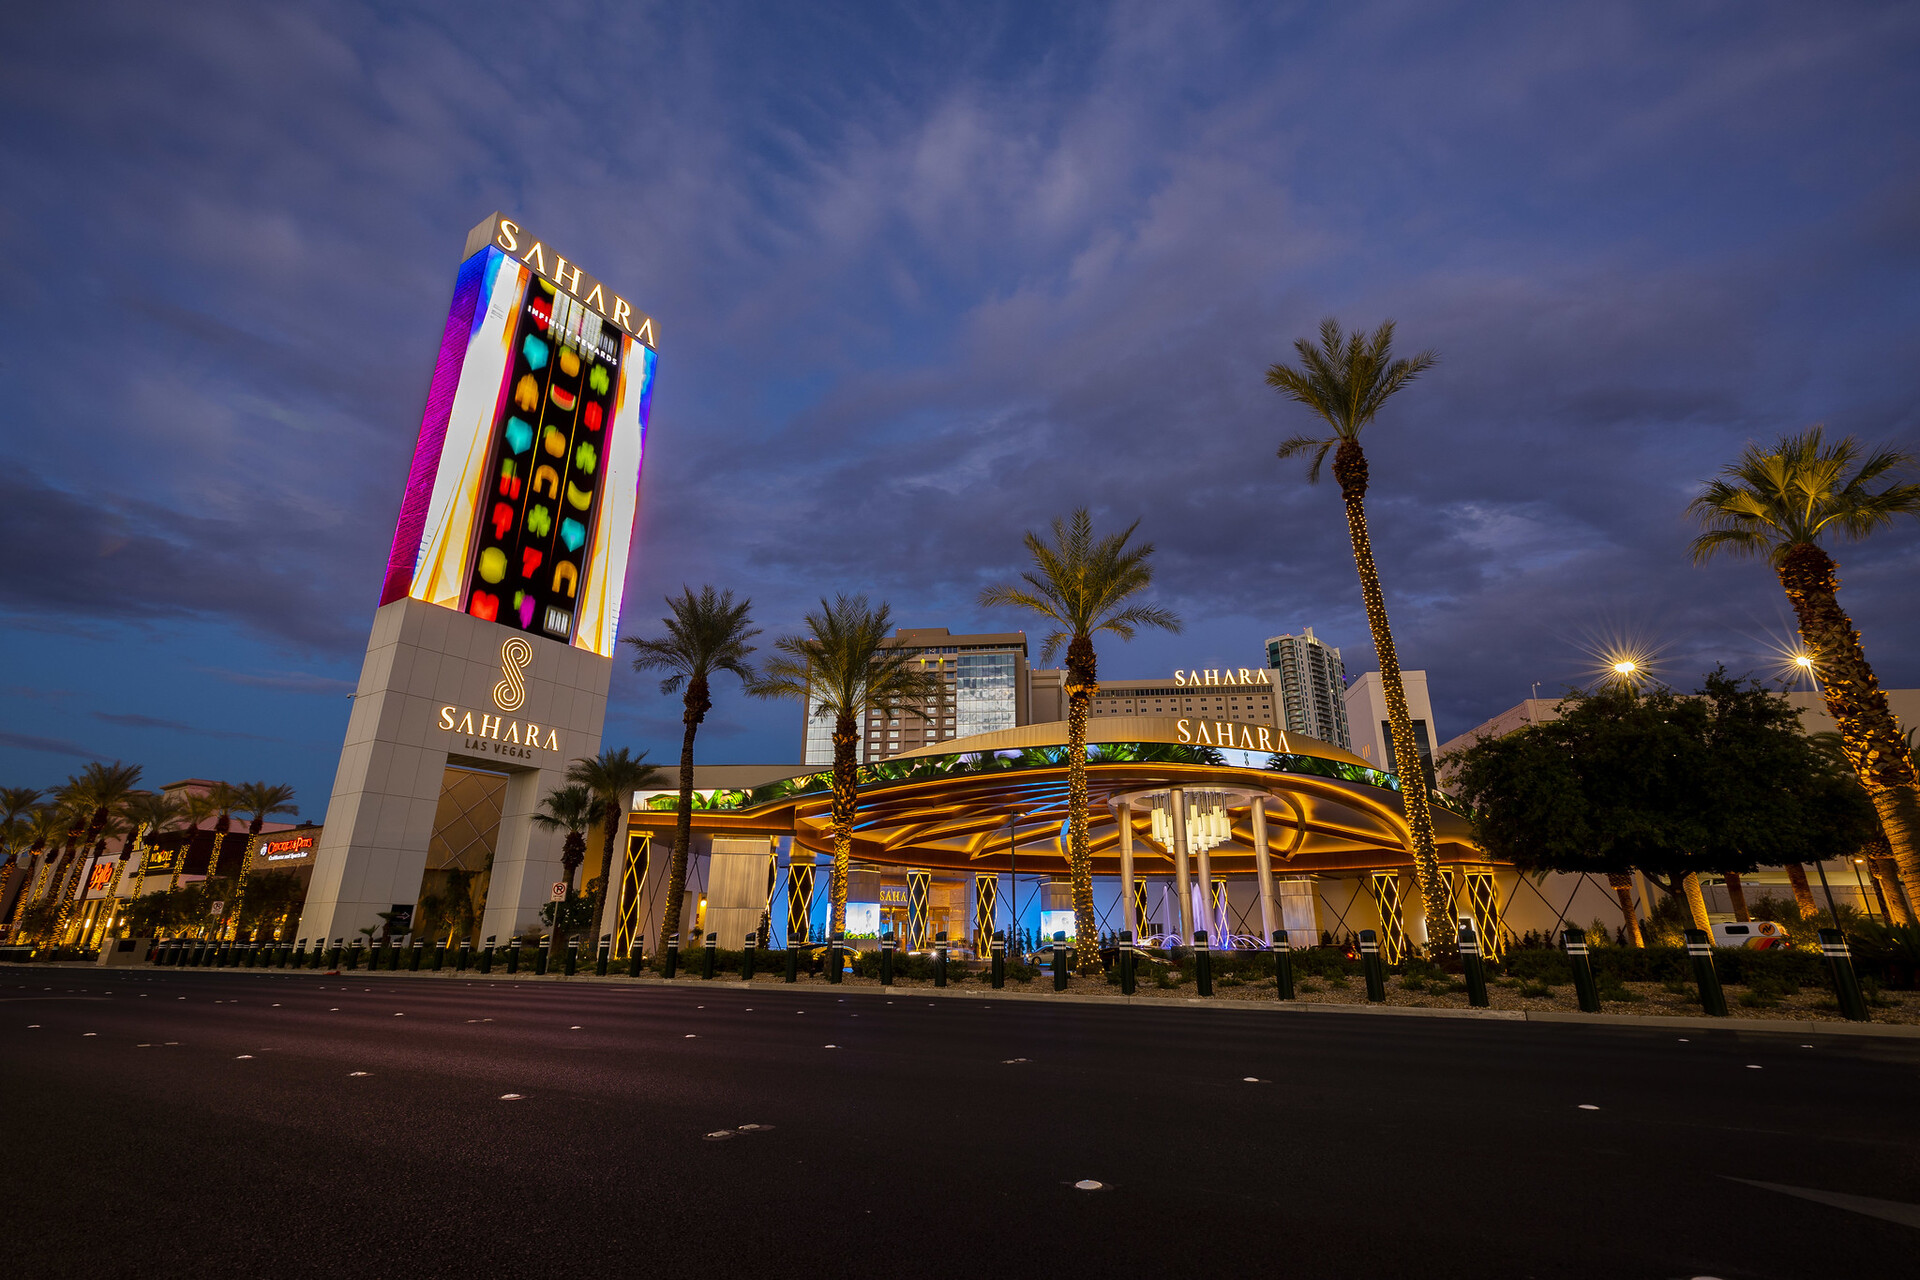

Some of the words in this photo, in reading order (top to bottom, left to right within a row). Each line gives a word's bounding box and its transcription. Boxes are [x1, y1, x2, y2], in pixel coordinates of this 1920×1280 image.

[497, 219, 656, 349] SAHARA
[575, 334, 618, 366] REWARDS
[1174, 668, 1270, 687] SAHARA
[438, 706, 560, 752] SAHARA
[1177, 719, 1292, 753] SAHARA
[464, 737, 488, 752] LAS
[493, 743, 533, 760] VEGAS
[880, 890, 907, 902] SAHA
